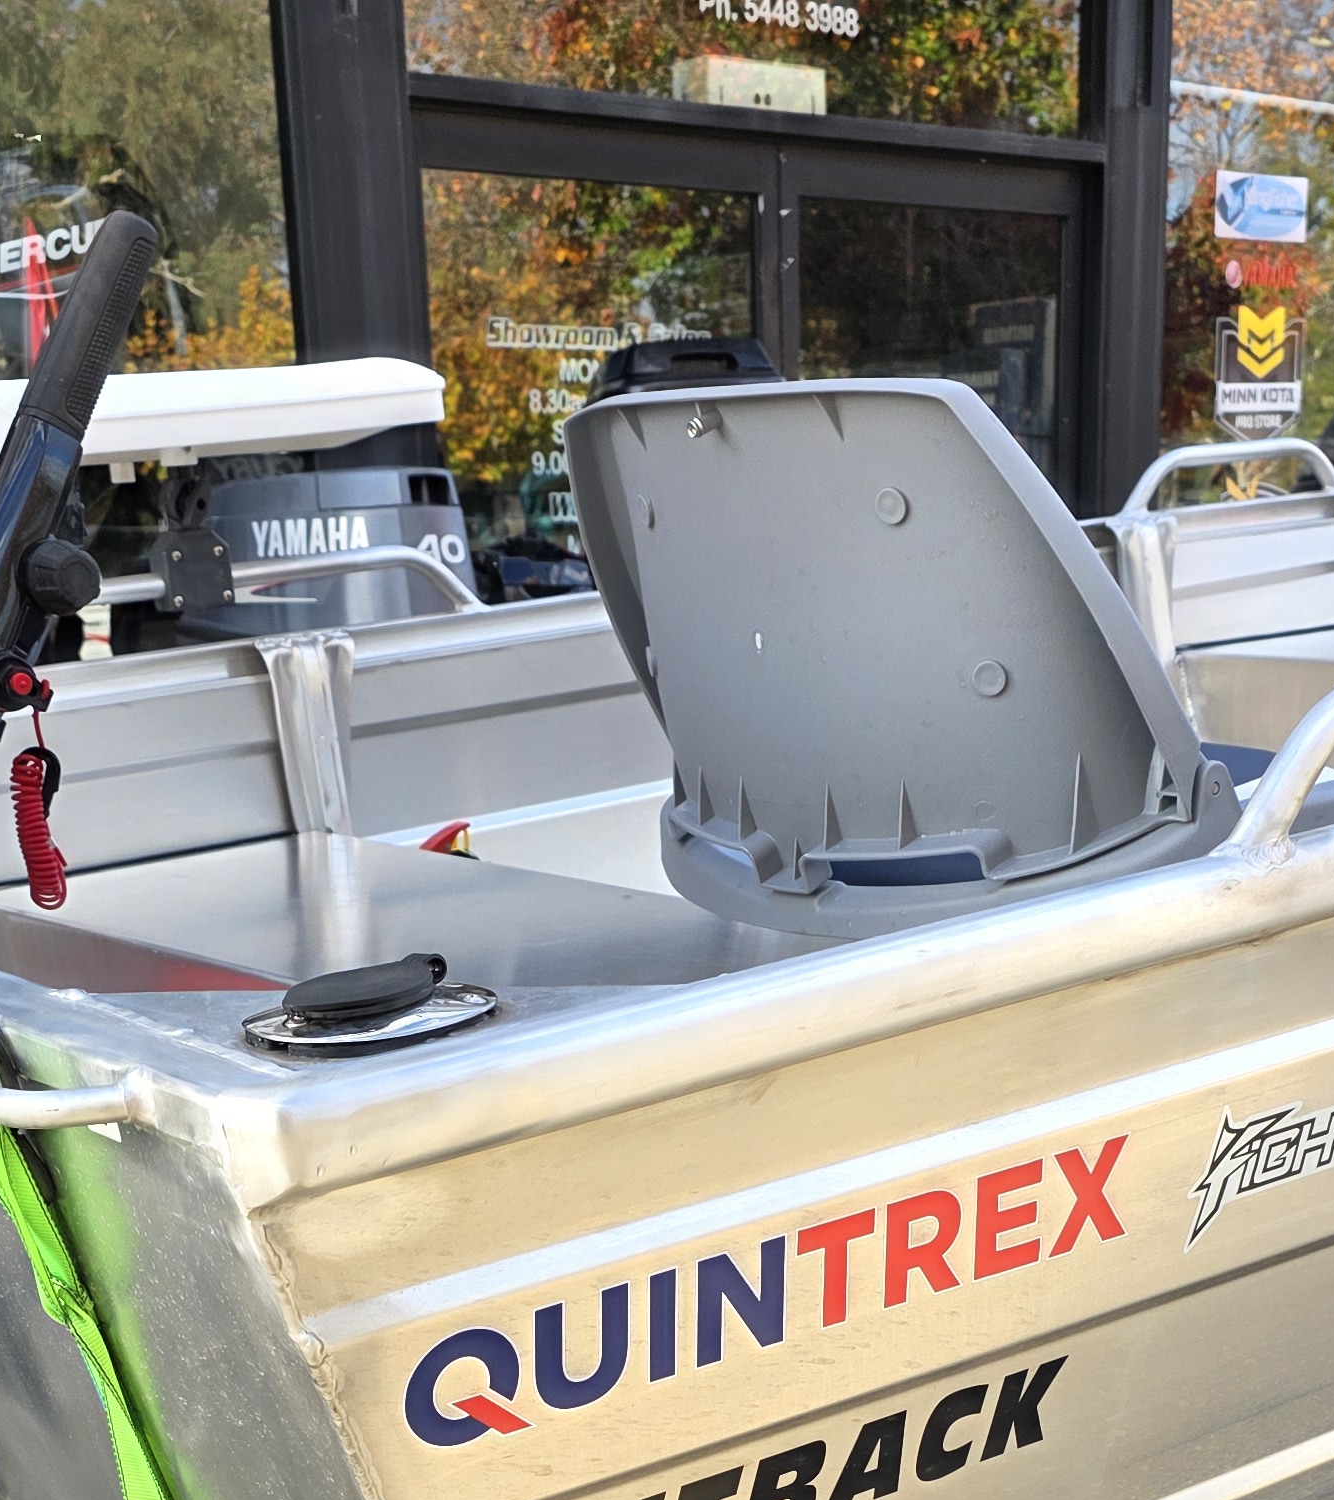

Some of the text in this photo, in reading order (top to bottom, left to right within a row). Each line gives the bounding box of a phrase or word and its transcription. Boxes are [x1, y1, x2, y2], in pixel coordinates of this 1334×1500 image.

[744, 0, 800, 28] 5448
[805, 2, 860, 38] 3988
[486, 317, 618, 350] Showroom
[559, 358, 599, 384] MO
[1221, 387, 1295, 404] MINN KOTA
[251, 515, 369, 558] YAMAHA
[416, 533, 466, 564] 40
[404, 1133, 1131, 1447] QUINTREX
